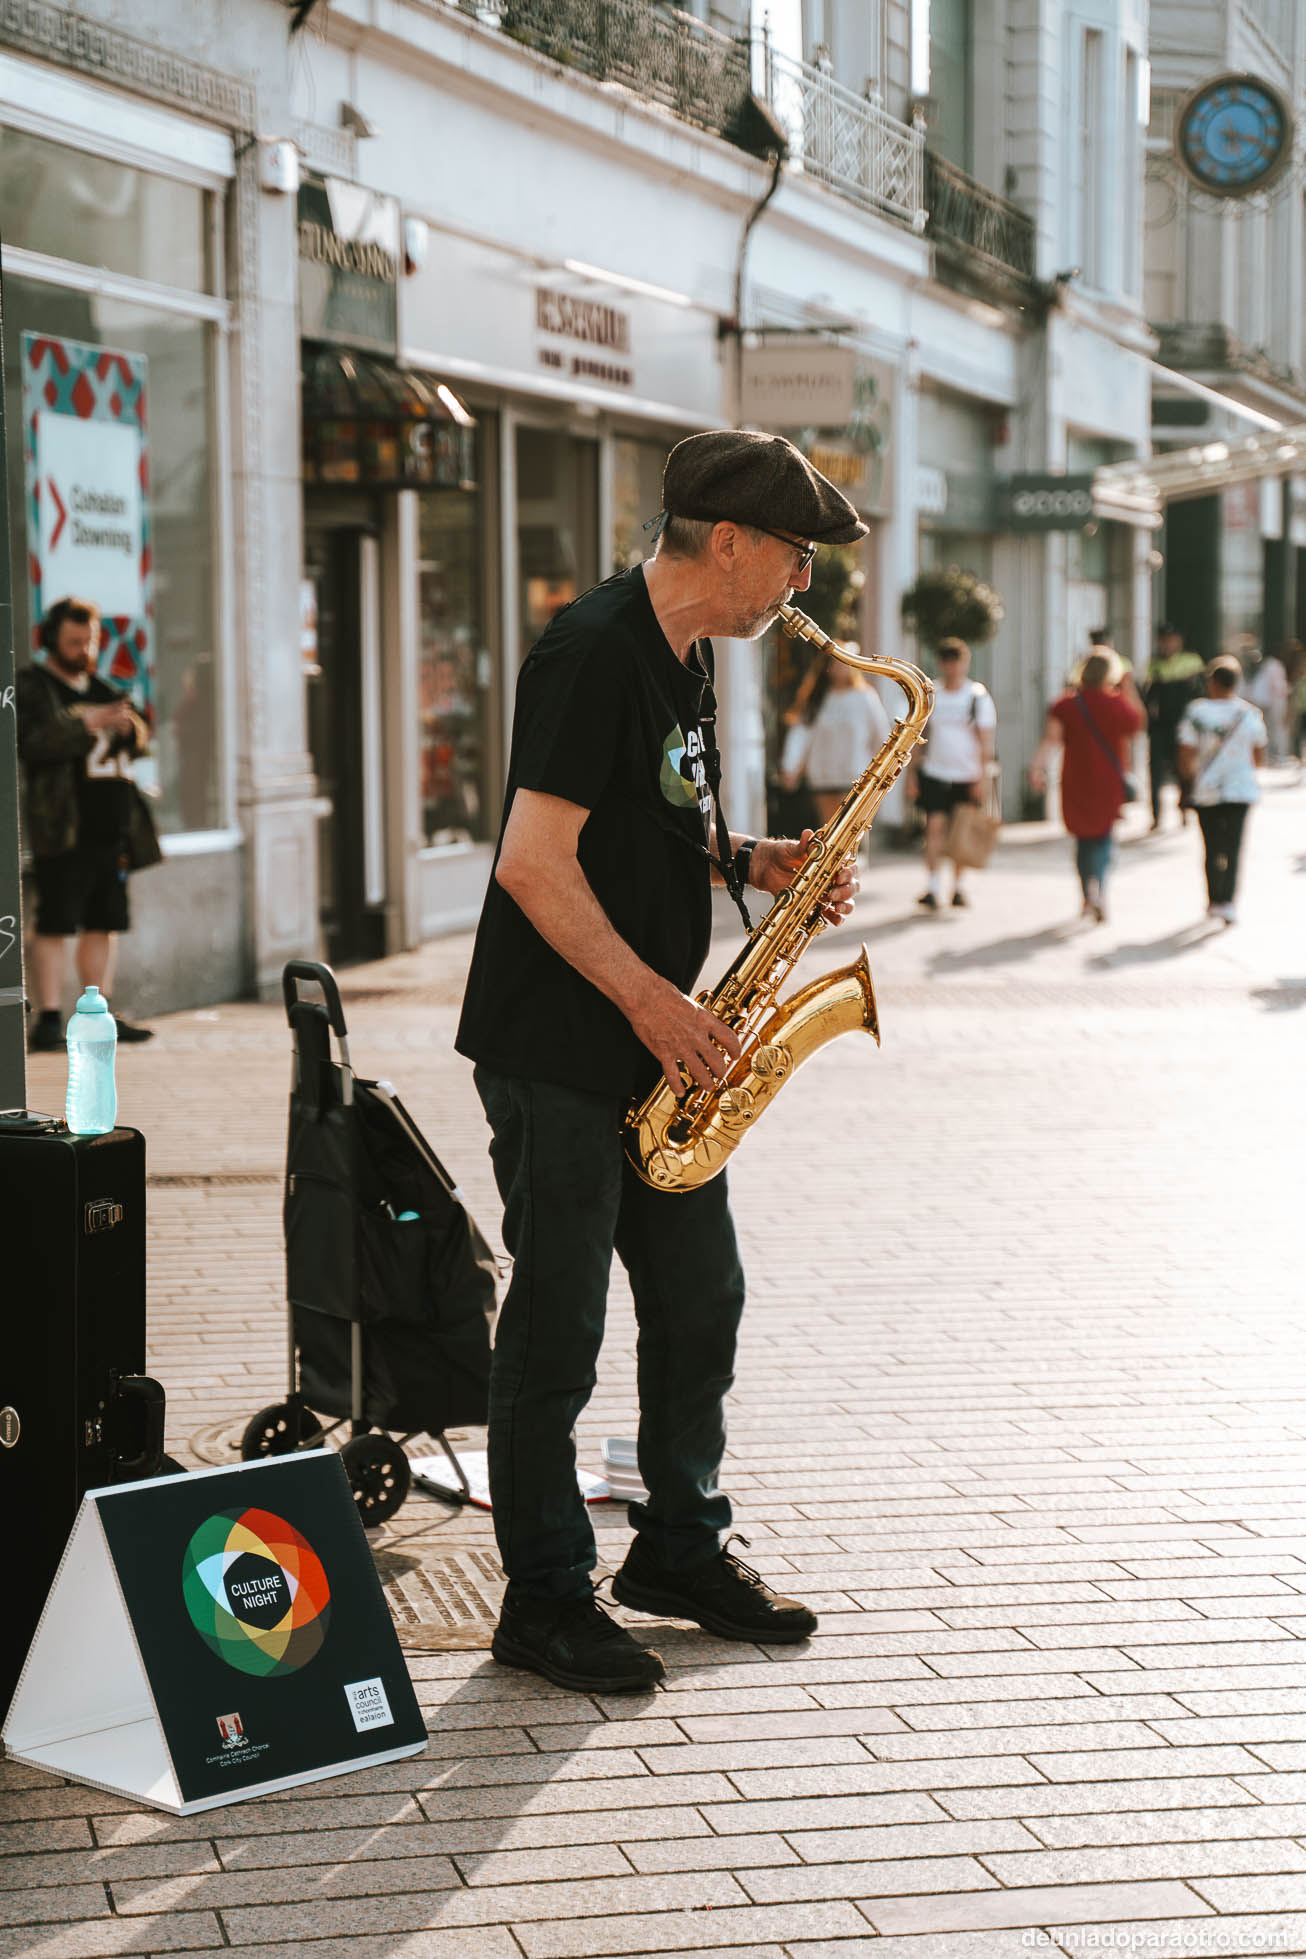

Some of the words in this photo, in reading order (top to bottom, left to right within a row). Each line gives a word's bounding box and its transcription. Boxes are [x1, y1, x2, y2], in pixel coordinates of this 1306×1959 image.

[231, 1575, 282, 1597] CULTURE
[242, 1590, 278, 1609] NIGHT
[357, 1686, 379, 1700] arts
[355, 1696, 382, 1709] council
